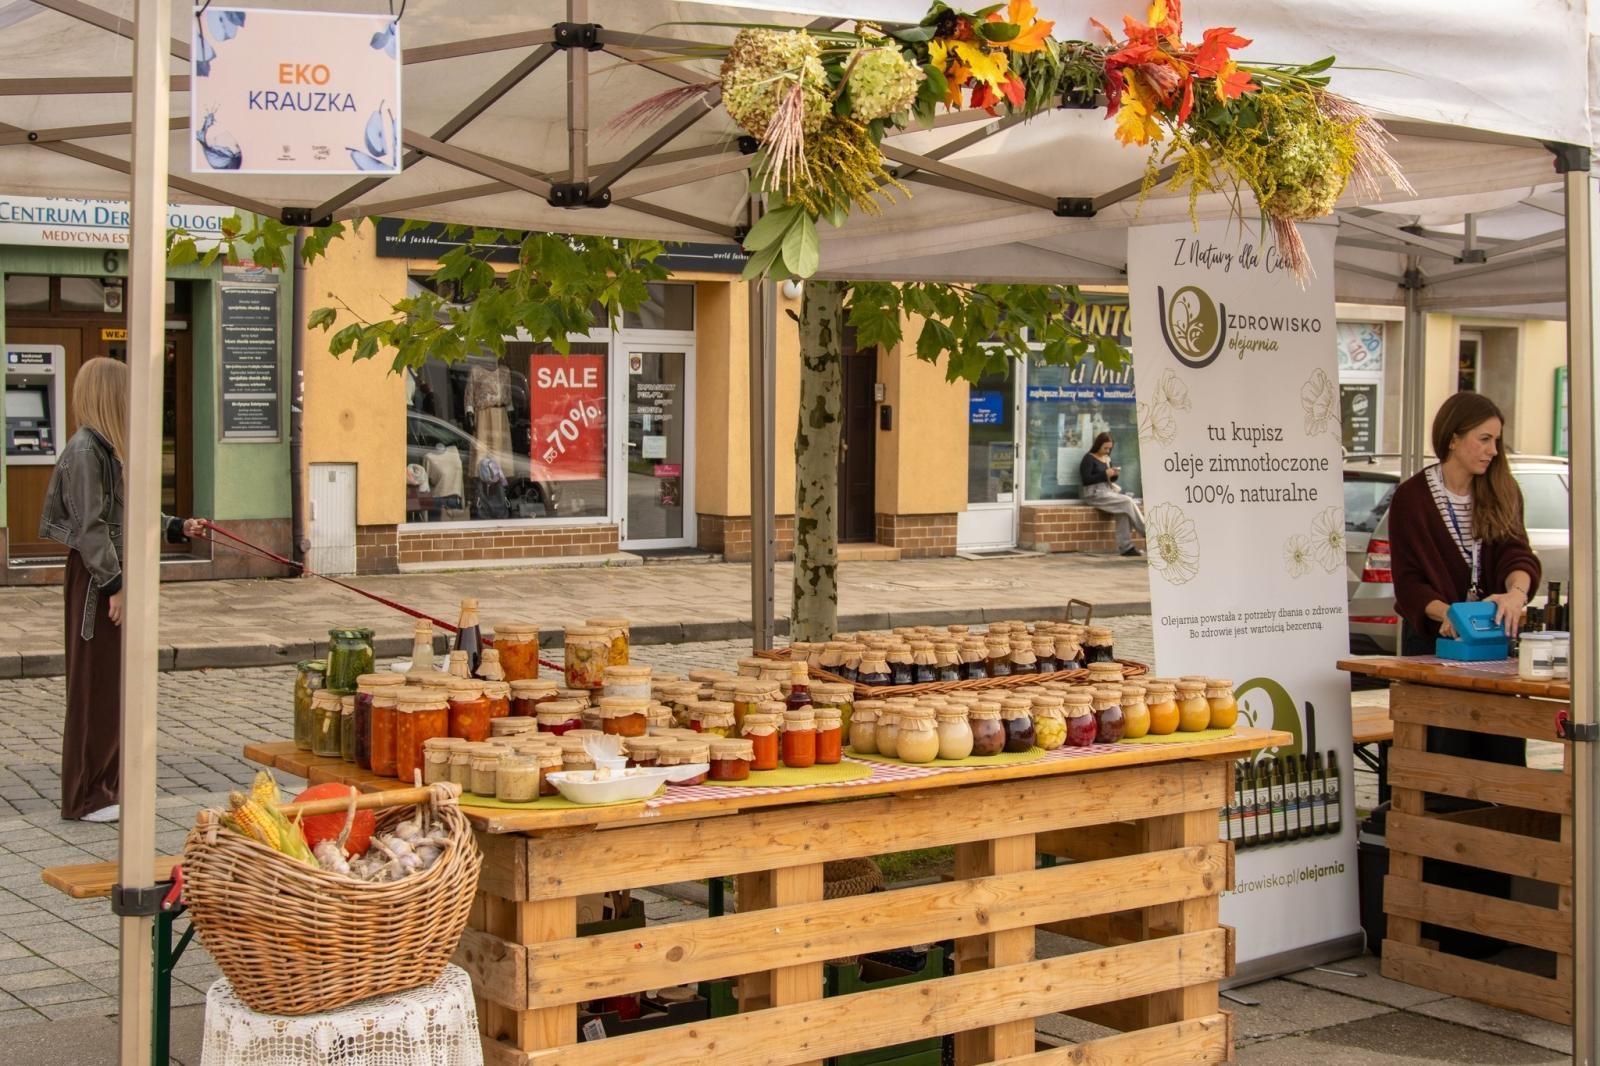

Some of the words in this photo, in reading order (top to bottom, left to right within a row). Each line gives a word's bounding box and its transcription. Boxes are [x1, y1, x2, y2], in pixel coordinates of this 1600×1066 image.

[279, 63, 331, 85] EKO
[249, 90, 357, 112] KRAUZKA
[0, 202, 87, 224] CENTRUM
[41, 230, 110, 243] MEDYCYNA
[112, 232, 130, 244] EST
[103, 250, 119, 273] 6
[1174, 238, 1186, 266] Z
[1190, 239, 1233, 272] Natury
[1239, 243, 1258, 270] dla
[1051, 303, 1131, 337] ANT
[1228, 331, 1279, 360] olejarnia
[537, 367, 598, 388] SALE
[1208, 424, 1226, 441] tu
[1231, 421, 1283, 448] kupisz
[1164, 452, 1204, 479] oleje
[1209, 452, 1329, 472] zimnotłoczone
[1185, 484, 1235, 504] 100%
[1240, 482, 1318, 502] naturalne
[1161, 615, 1199, 628] Olejarnia
[1200, 611, 1236, 627] powstała
[1244, 609, 1277, 623] potrzeby
[1278, 607, 1303, 618] dbania
[1189, 629, 1200, 639] Bo
[1201, 627, 1233, 638] zdrowie
[1234, 626, 1248, 639] jest
[1250, 625, 1285, 635] wartością
